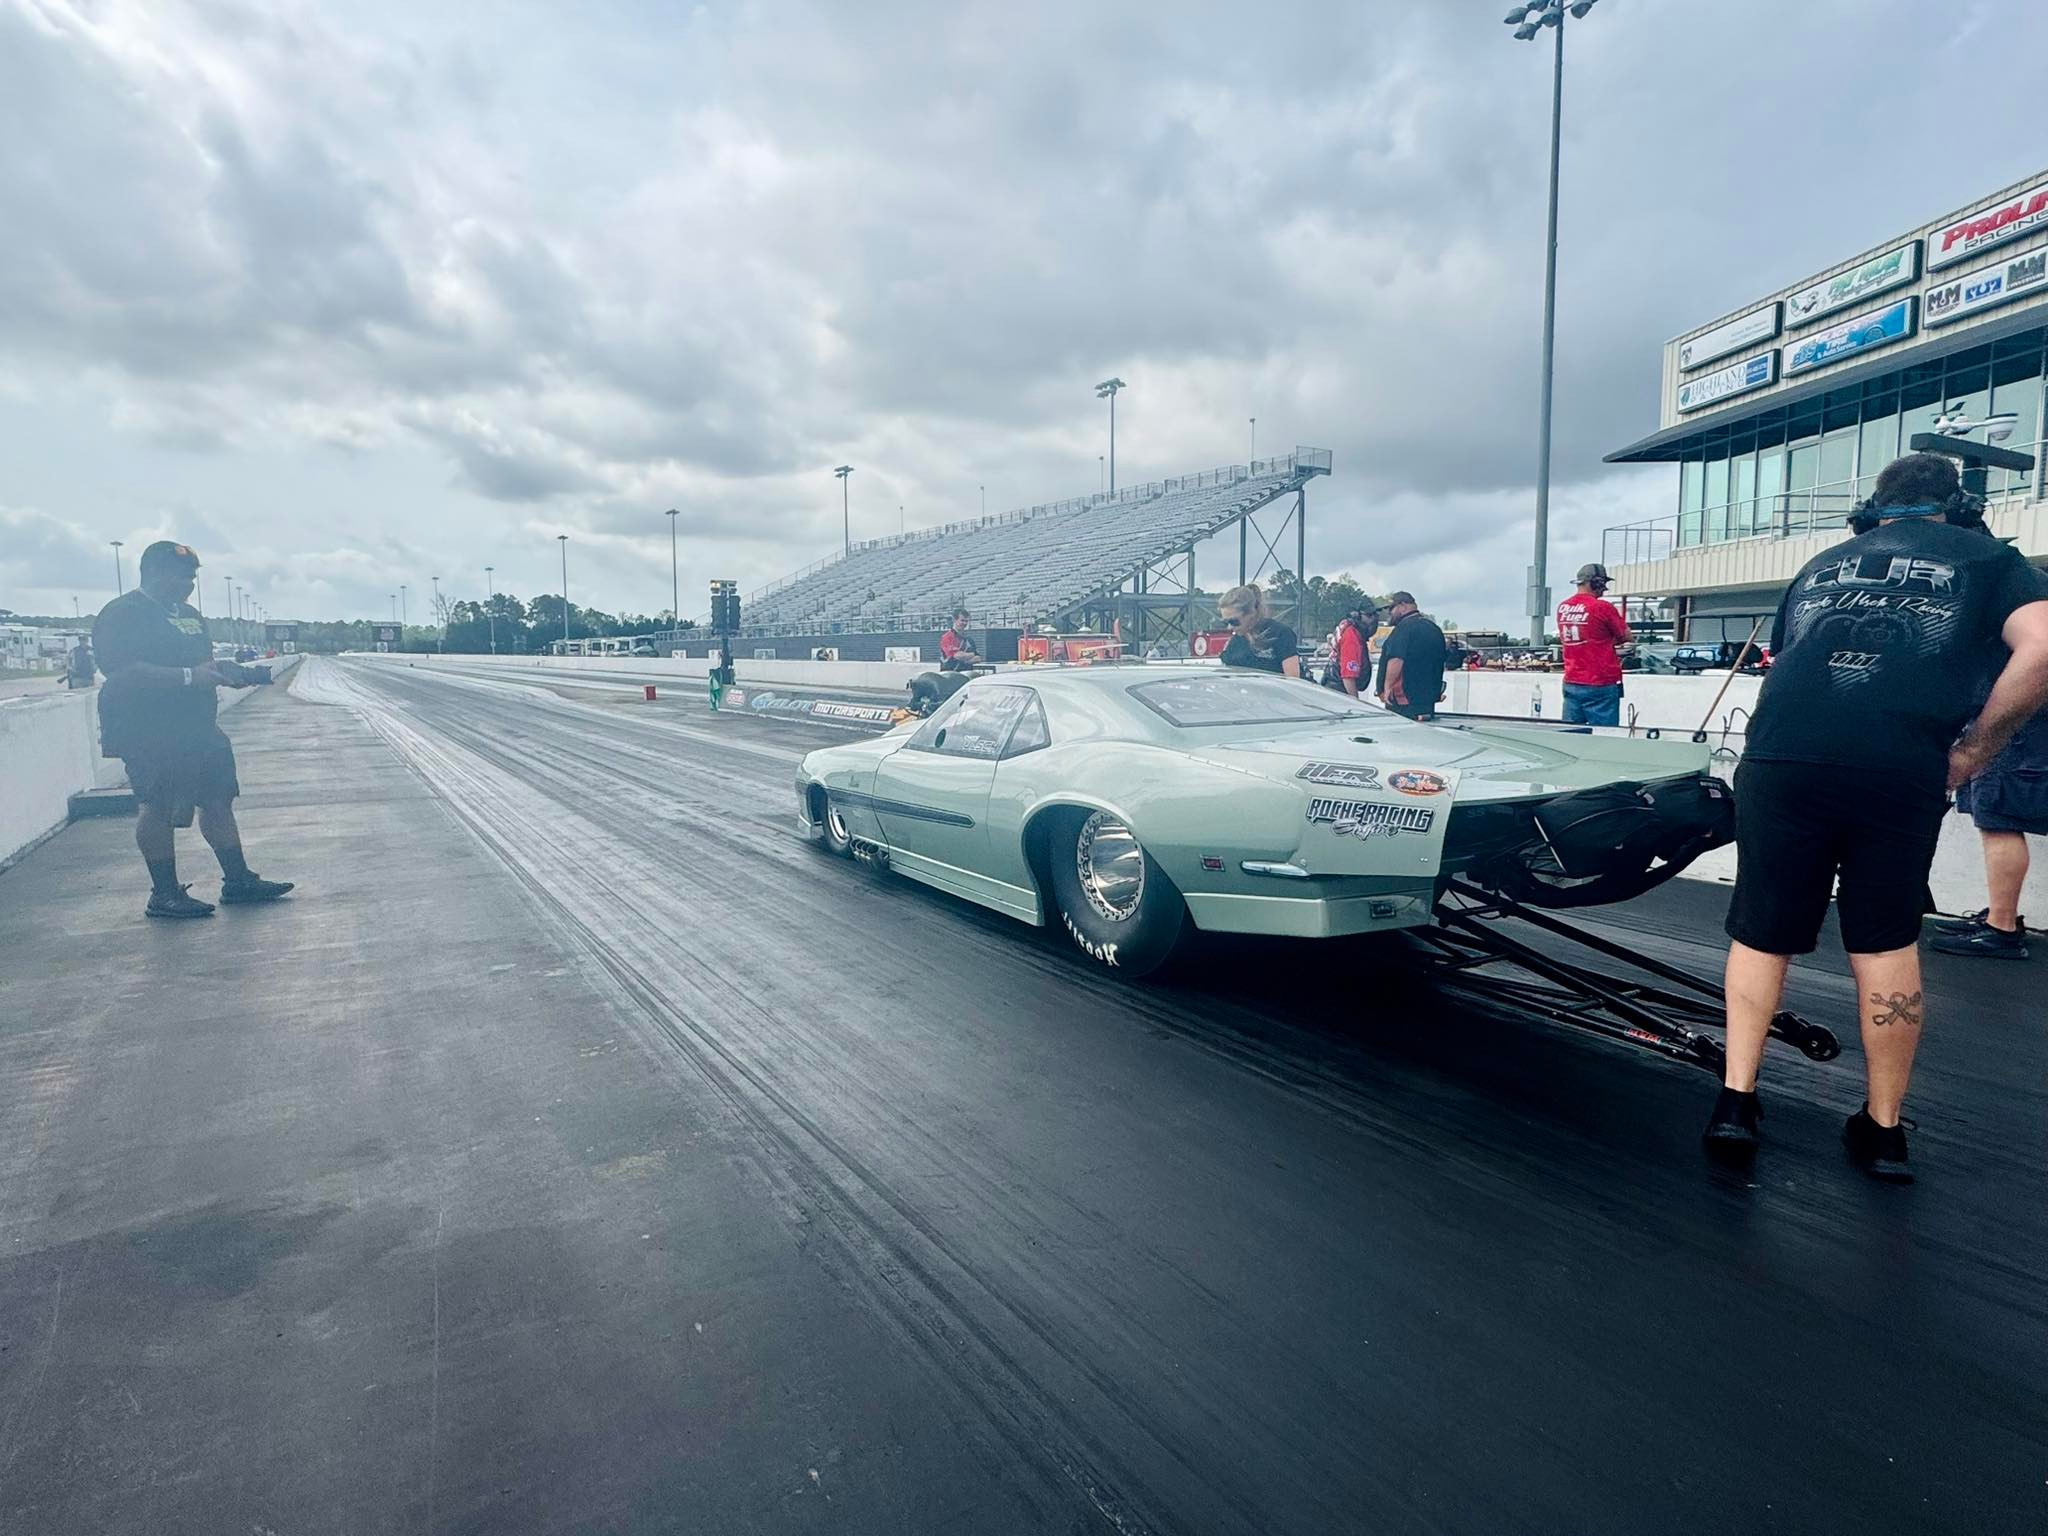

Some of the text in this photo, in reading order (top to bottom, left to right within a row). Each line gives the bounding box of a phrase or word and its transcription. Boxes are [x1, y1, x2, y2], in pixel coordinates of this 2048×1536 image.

[1691, 365, 1746, 398] HIGHLAND
[1559, 603, 1586, 614] Quik
[1560, 612, 1589, 622] Fuel
[1897, 597, 1953, 620] Racing
[814, 702, 891, 721] MOTORSPORTS
